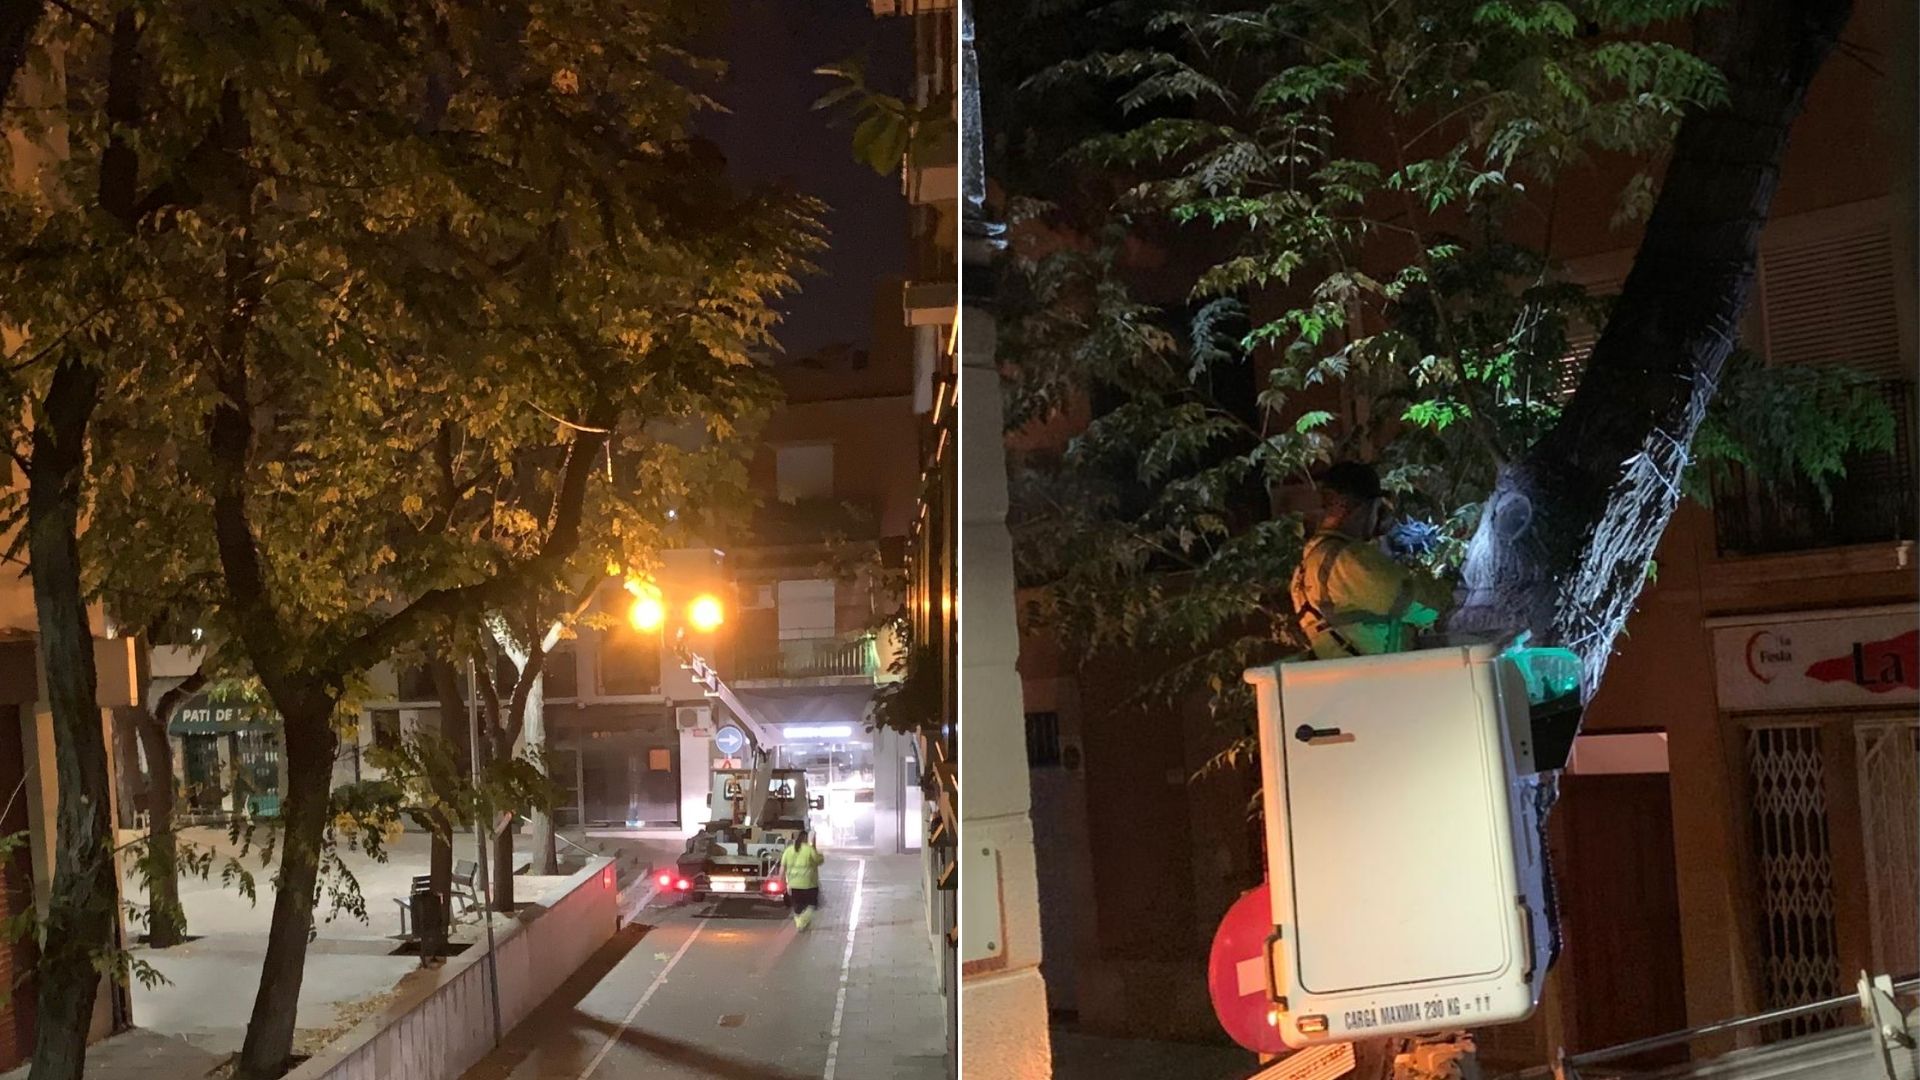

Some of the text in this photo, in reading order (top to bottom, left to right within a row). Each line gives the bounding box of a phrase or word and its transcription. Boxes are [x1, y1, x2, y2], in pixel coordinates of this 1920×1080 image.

[1853, 642, 1905, 686] La
[182, 709, 210, 722] PATI
[215, 709, 233, 722] DE
[1344, 1008, 1378, 1030] CARGA
[1380, 1002, 1421, 1025] MAXIMA
[1424, 999, 1444, 1019] 230
[1447, 997, 1460, 1016] KG
